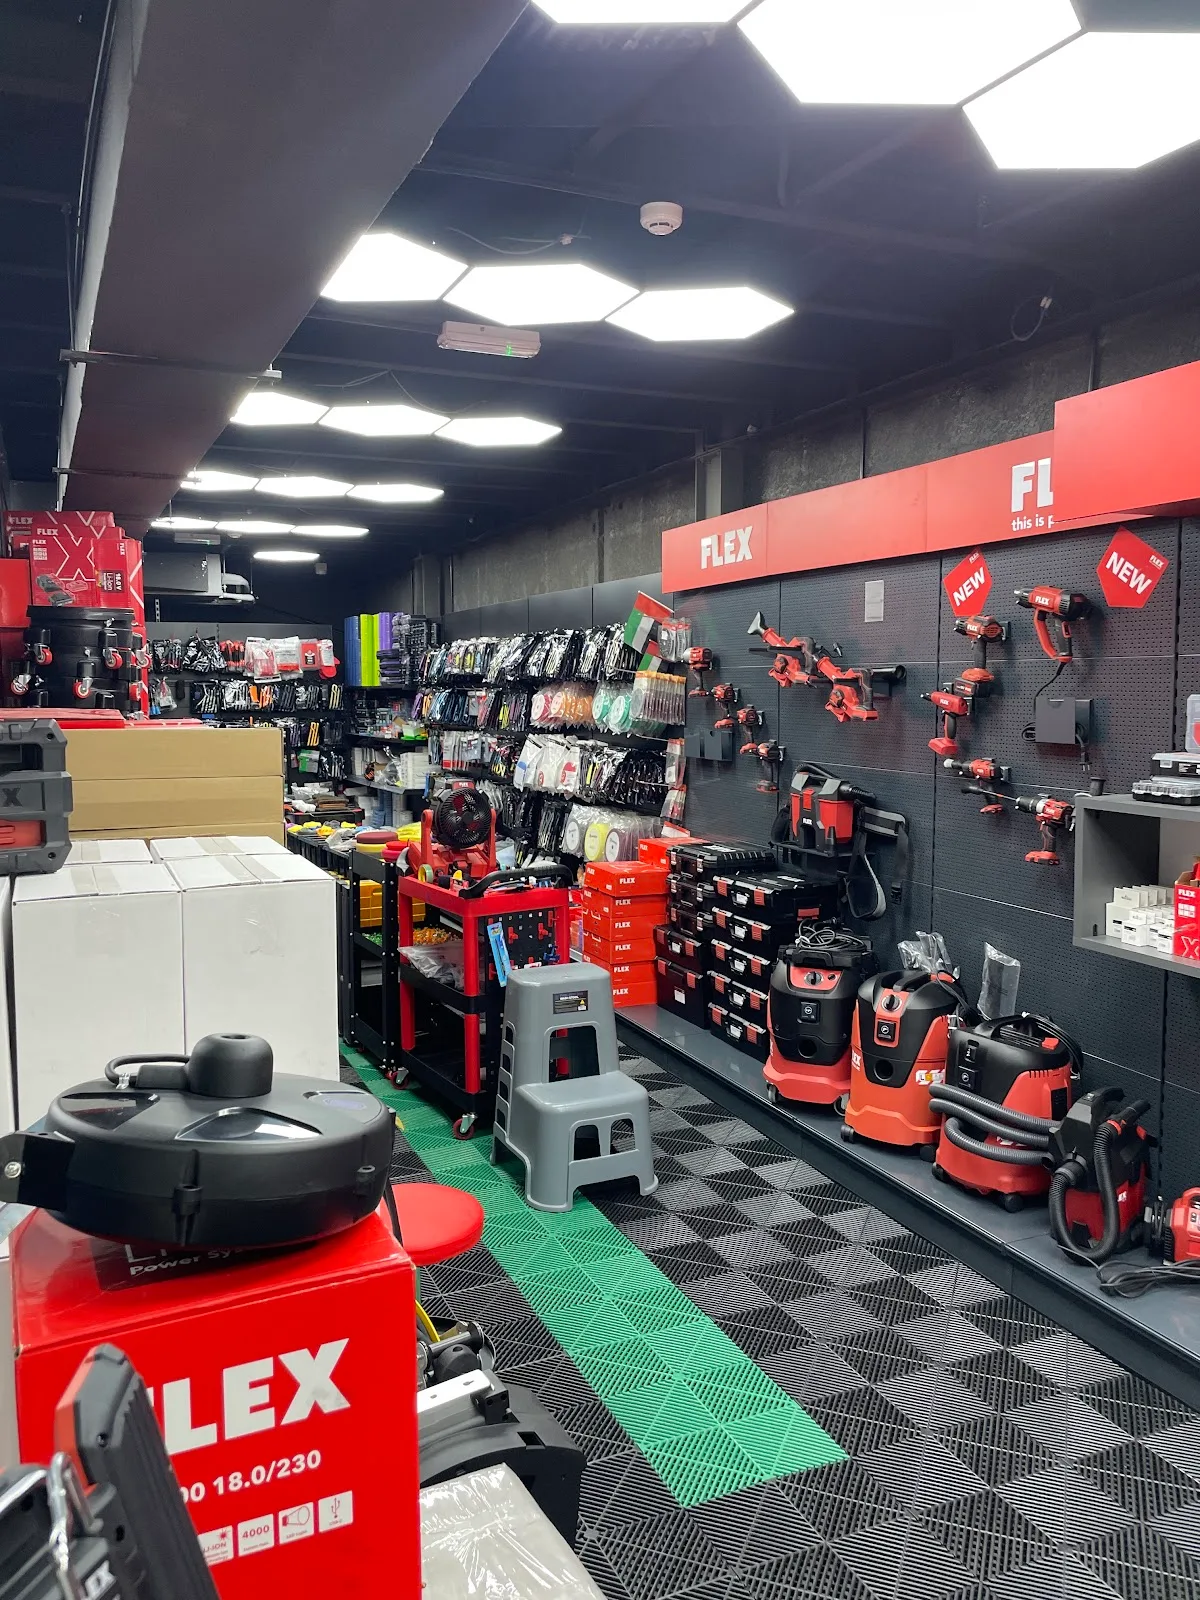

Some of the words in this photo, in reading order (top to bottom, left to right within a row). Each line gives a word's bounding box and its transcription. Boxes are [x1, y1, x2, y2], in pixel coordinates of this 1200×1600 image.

[10, 516, 34, 525] FLEX
[1011, 516, 1032, 532] this
[1035, 514, 1044, 527] is
[37, 528, 58, 536] FLEX
[701, 525, 753, 570] FLEX
[1149, 555, 1165, 569] FLEX
[1105, 551, 1153, 596] NEW
[952, 566, 986, 607] NEW
[1035, 596, 1050, 606] FLEX
[966, 623, 979, 633] FLEX
[802, 817, 813, 825] FLEX
[639, 843, 649, 851] FLEX
[619, 877, 635, 885] FLEX
[1177, 888, 1197, 899] FLEX
[614, 921, 631, 929] FLEX
[615, 943, 631, 952] FLEX
[612, 988, 629, 996] FLEX
[129, 1255, 201, 1275] Power
[146, 1337, 352, 1456] LEX
[213, 1449, 322, 1496] 18.0/230
[242, 1524, 270, 1539] 4000
